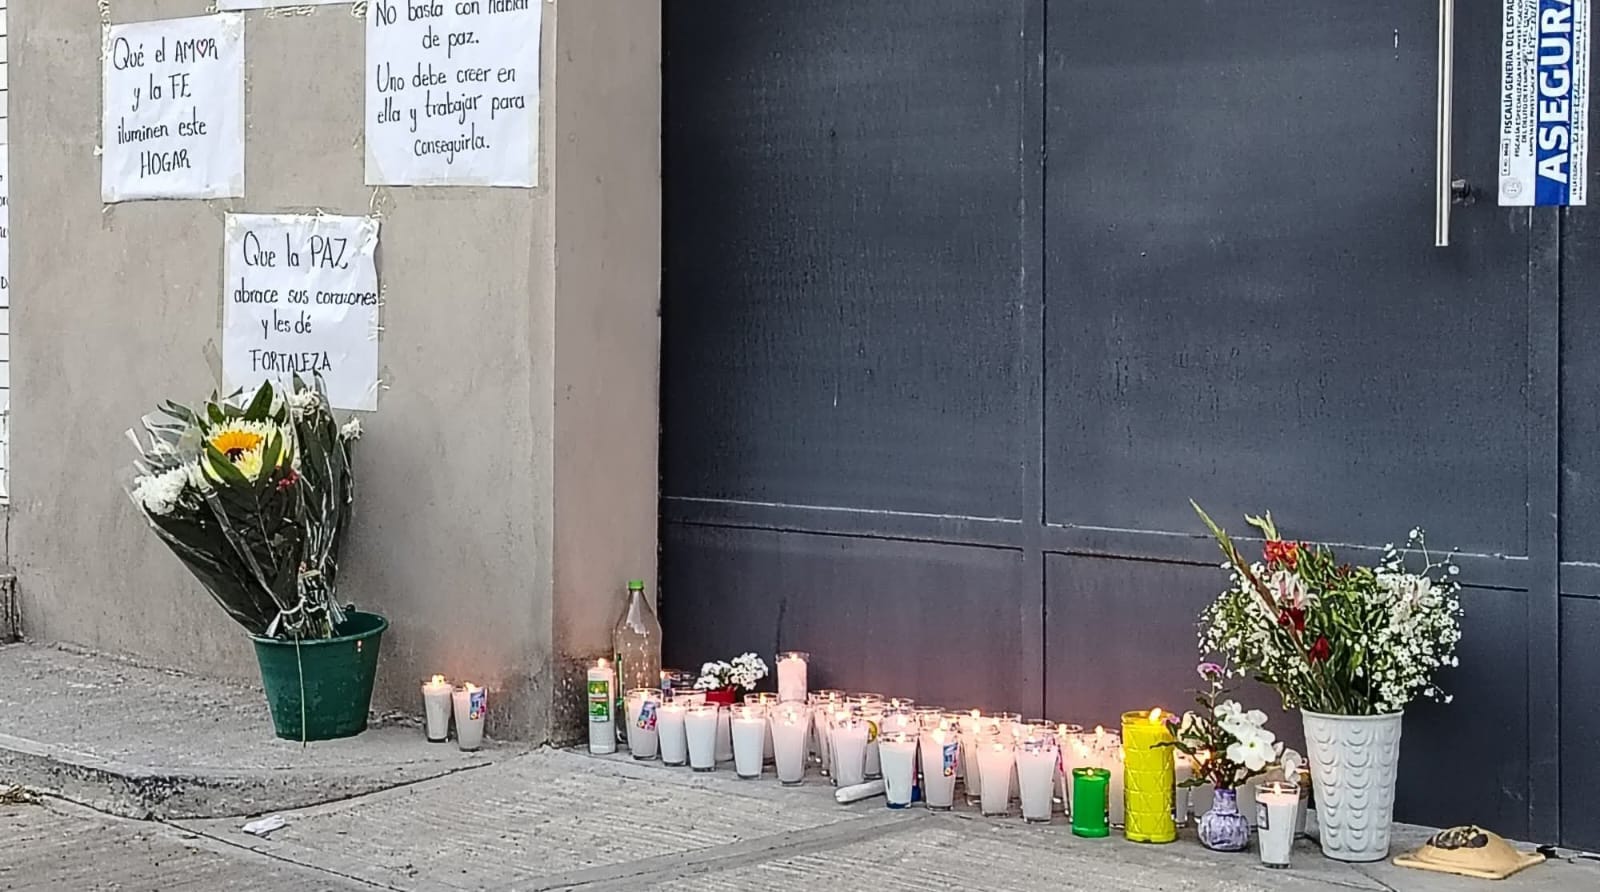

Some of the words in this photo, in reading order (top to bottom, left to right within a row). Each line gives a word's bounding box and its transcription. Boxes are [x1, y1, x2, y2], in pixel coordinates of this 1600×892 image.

[375, 0, 398, 28] No
[407, 0, 444, 22] basta
[454, 0, 480, 16] con
[113, 36, 145, 71] Qué
[155, 36, 166, 63] el
[421, 25, 441, 49] de
[447, 31, 480, 59] paz.
[1506, 28, 1514, 47] DEL
[376, 61, 405, 93] Uno
[411, 61, 447, 88] debe
[456, 67, 492, 84] creer
[496, 67, 516, 84] en
[1505, 49, 1514, 91] GENERAL
[131, 87, 141, 113] y
[149, 73, 162, 100] la
[167, 72, 192, 100] FE
[1538, 0, 1572, 184] ASEGUR
[117, 116, 169, 145] iluminen
[178, 105, 208, 137] este
[377, 96, 401, 124] ella
[409, 108, 417, 134] y
[425, 89, 483, 126] trabajar
[491, 95, 525, 121] para
[140, 148, 192, 179] HOGAR
[243, 230, 276, 267] Que
[286, 231, 300, 267] la
[310, 234, 349, 270] PAZ
[234, 276, 279, 304] abrace
[287, 288, 309, 304] sus
[261, 318, 269, 340] y
[273, 308, 291, 333] les
[294, 309, 313, 334] dé
[248, 348, 332, 373] FORTALEZA
